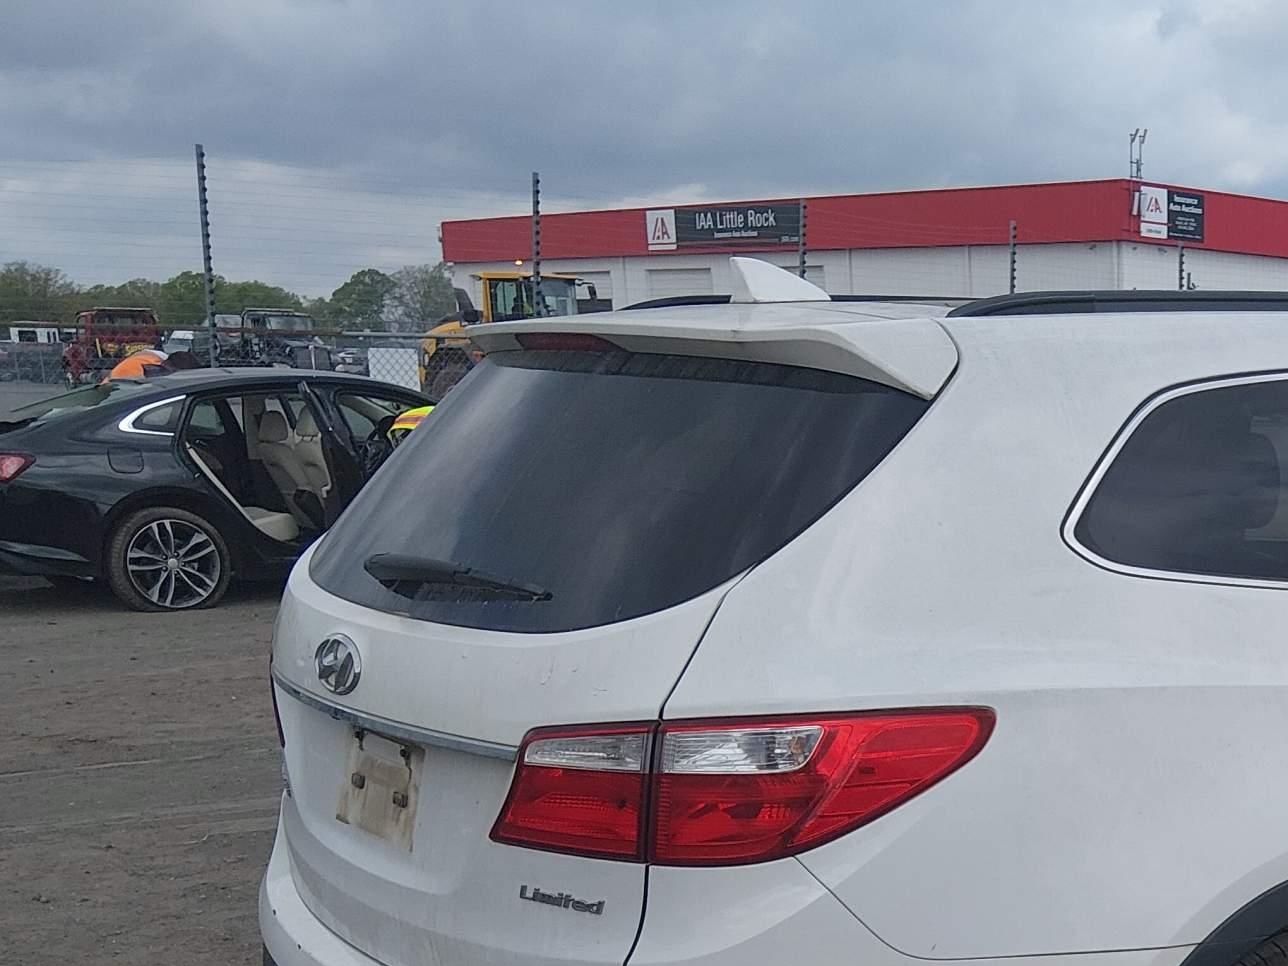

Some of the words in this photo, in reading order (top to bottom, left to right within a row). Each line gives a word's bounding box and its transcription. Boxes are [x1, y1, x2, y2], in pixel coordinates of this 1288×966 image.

[695, 212, 714, 230] IAA
[716, 210, 744, 229] Little
[747, 208, 777, 228] Rock
[519, 885, 606, 915] Limited
